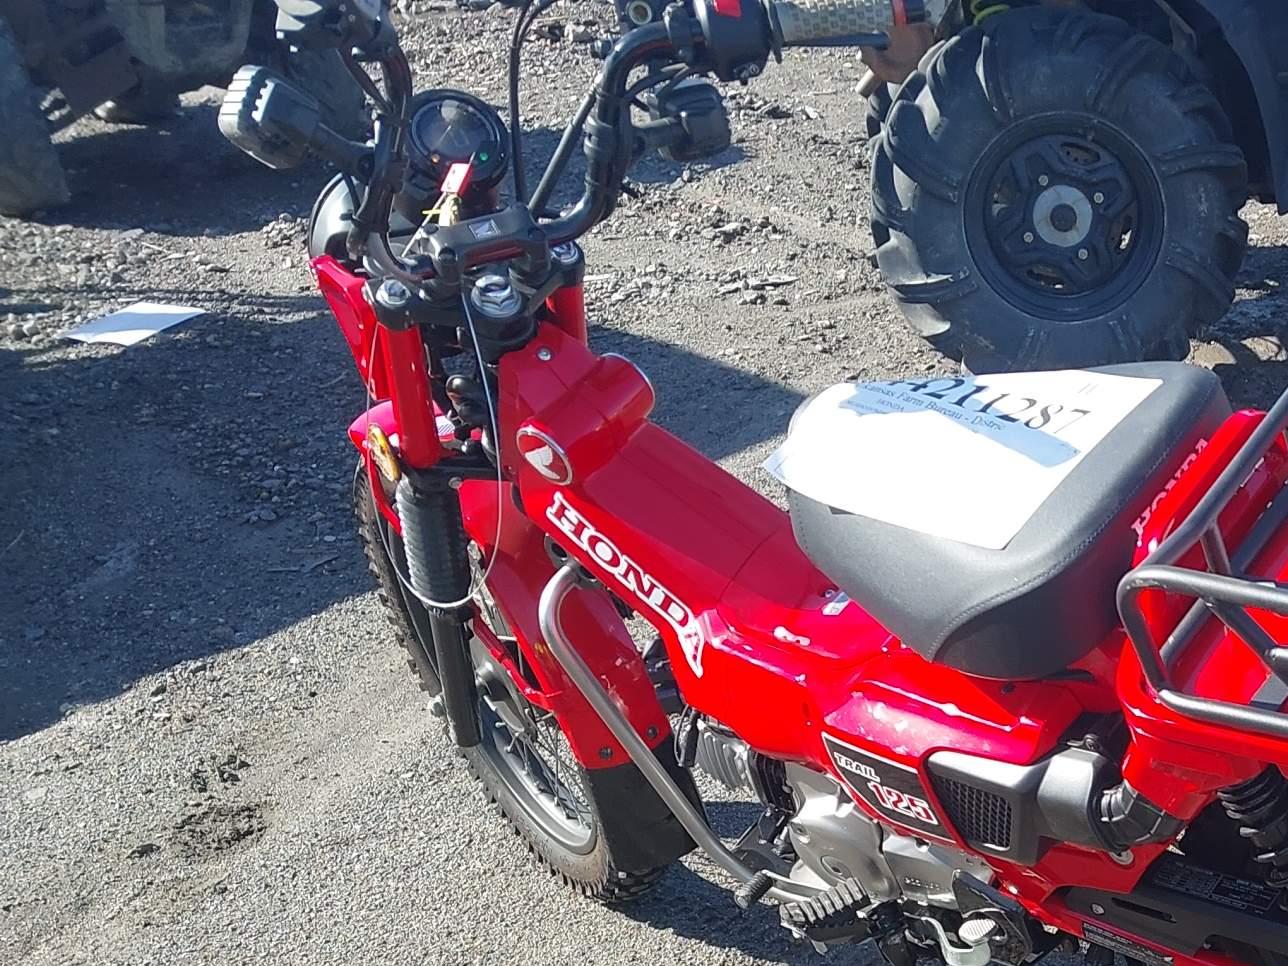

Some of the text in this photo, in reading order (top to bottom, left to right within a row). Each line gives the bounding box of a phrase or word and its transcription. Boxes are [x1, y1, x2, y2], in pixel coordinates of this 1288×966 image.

[899, 390, 925, 407] Farm
[925, 400, 963, 421] Bureau
[546, 491, 704, 679] HONDA
[834, 752, 880, 782] TRAIL
[867, 781, 939, 825] 125
